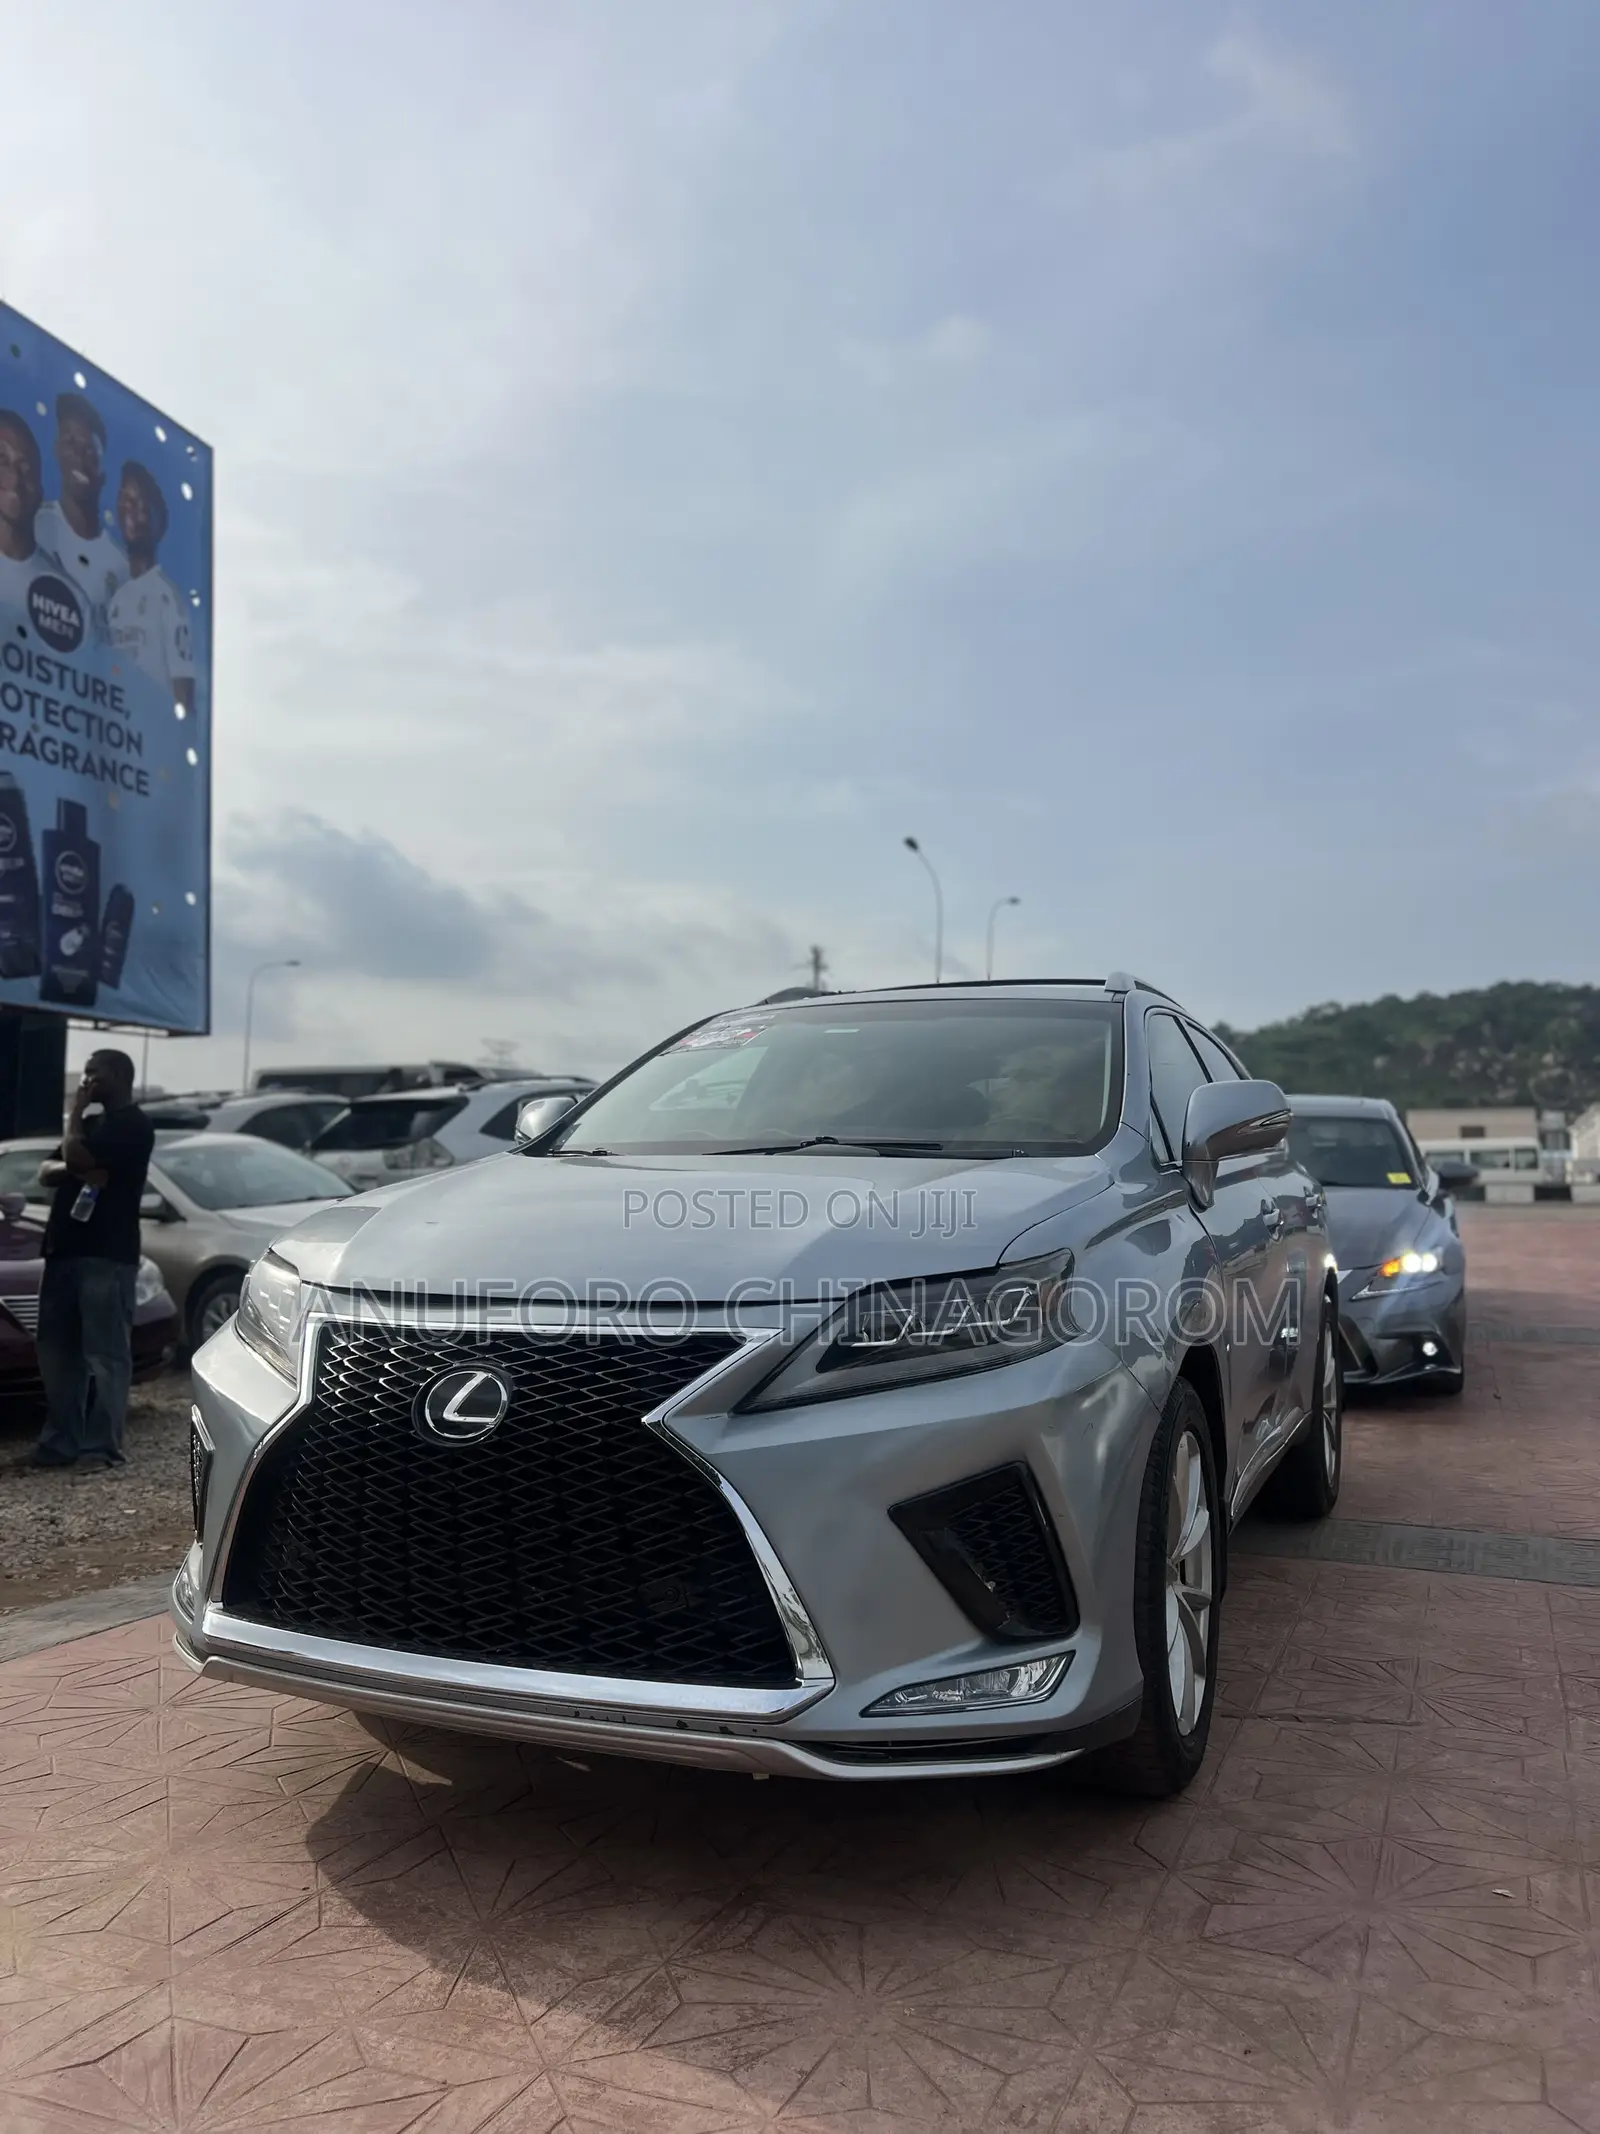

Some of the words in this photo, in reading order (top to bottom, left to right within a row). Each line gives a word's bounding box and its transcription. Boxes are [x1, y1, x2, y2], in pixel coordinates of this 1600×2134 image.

[32, 592, 80, 627] NIVEA
[38, 613, 75, 640] MEN
[0, 641, 131, 720] OISTURE,
